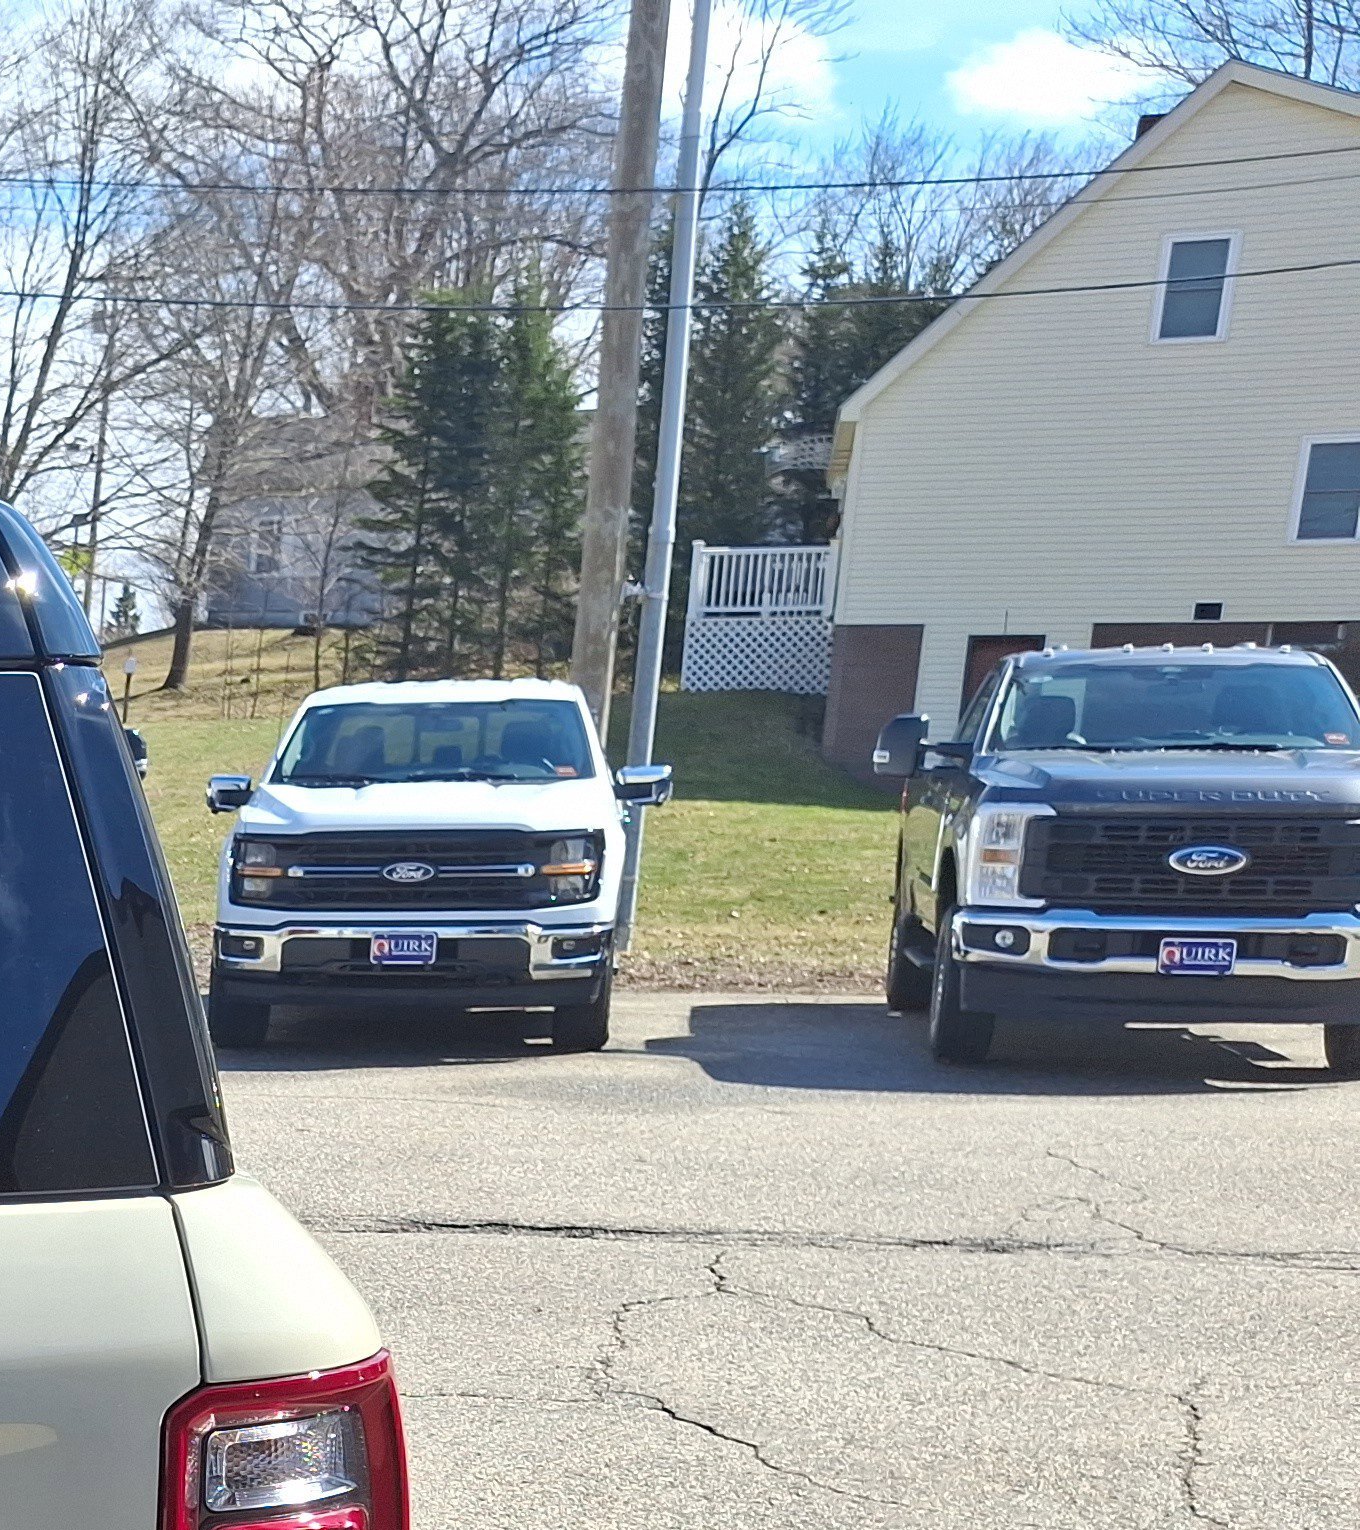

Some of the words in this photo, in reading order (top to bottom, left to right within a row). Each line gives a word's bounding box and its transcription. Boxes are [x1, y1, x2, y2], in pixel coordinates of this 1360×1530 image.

[1186, 852, 1229, 869] Ford
[392, 866, 425, 879] Ford
[374, 939, 432, 956] QUIRK
[1162, 946, 1231, 964] QUIRK
